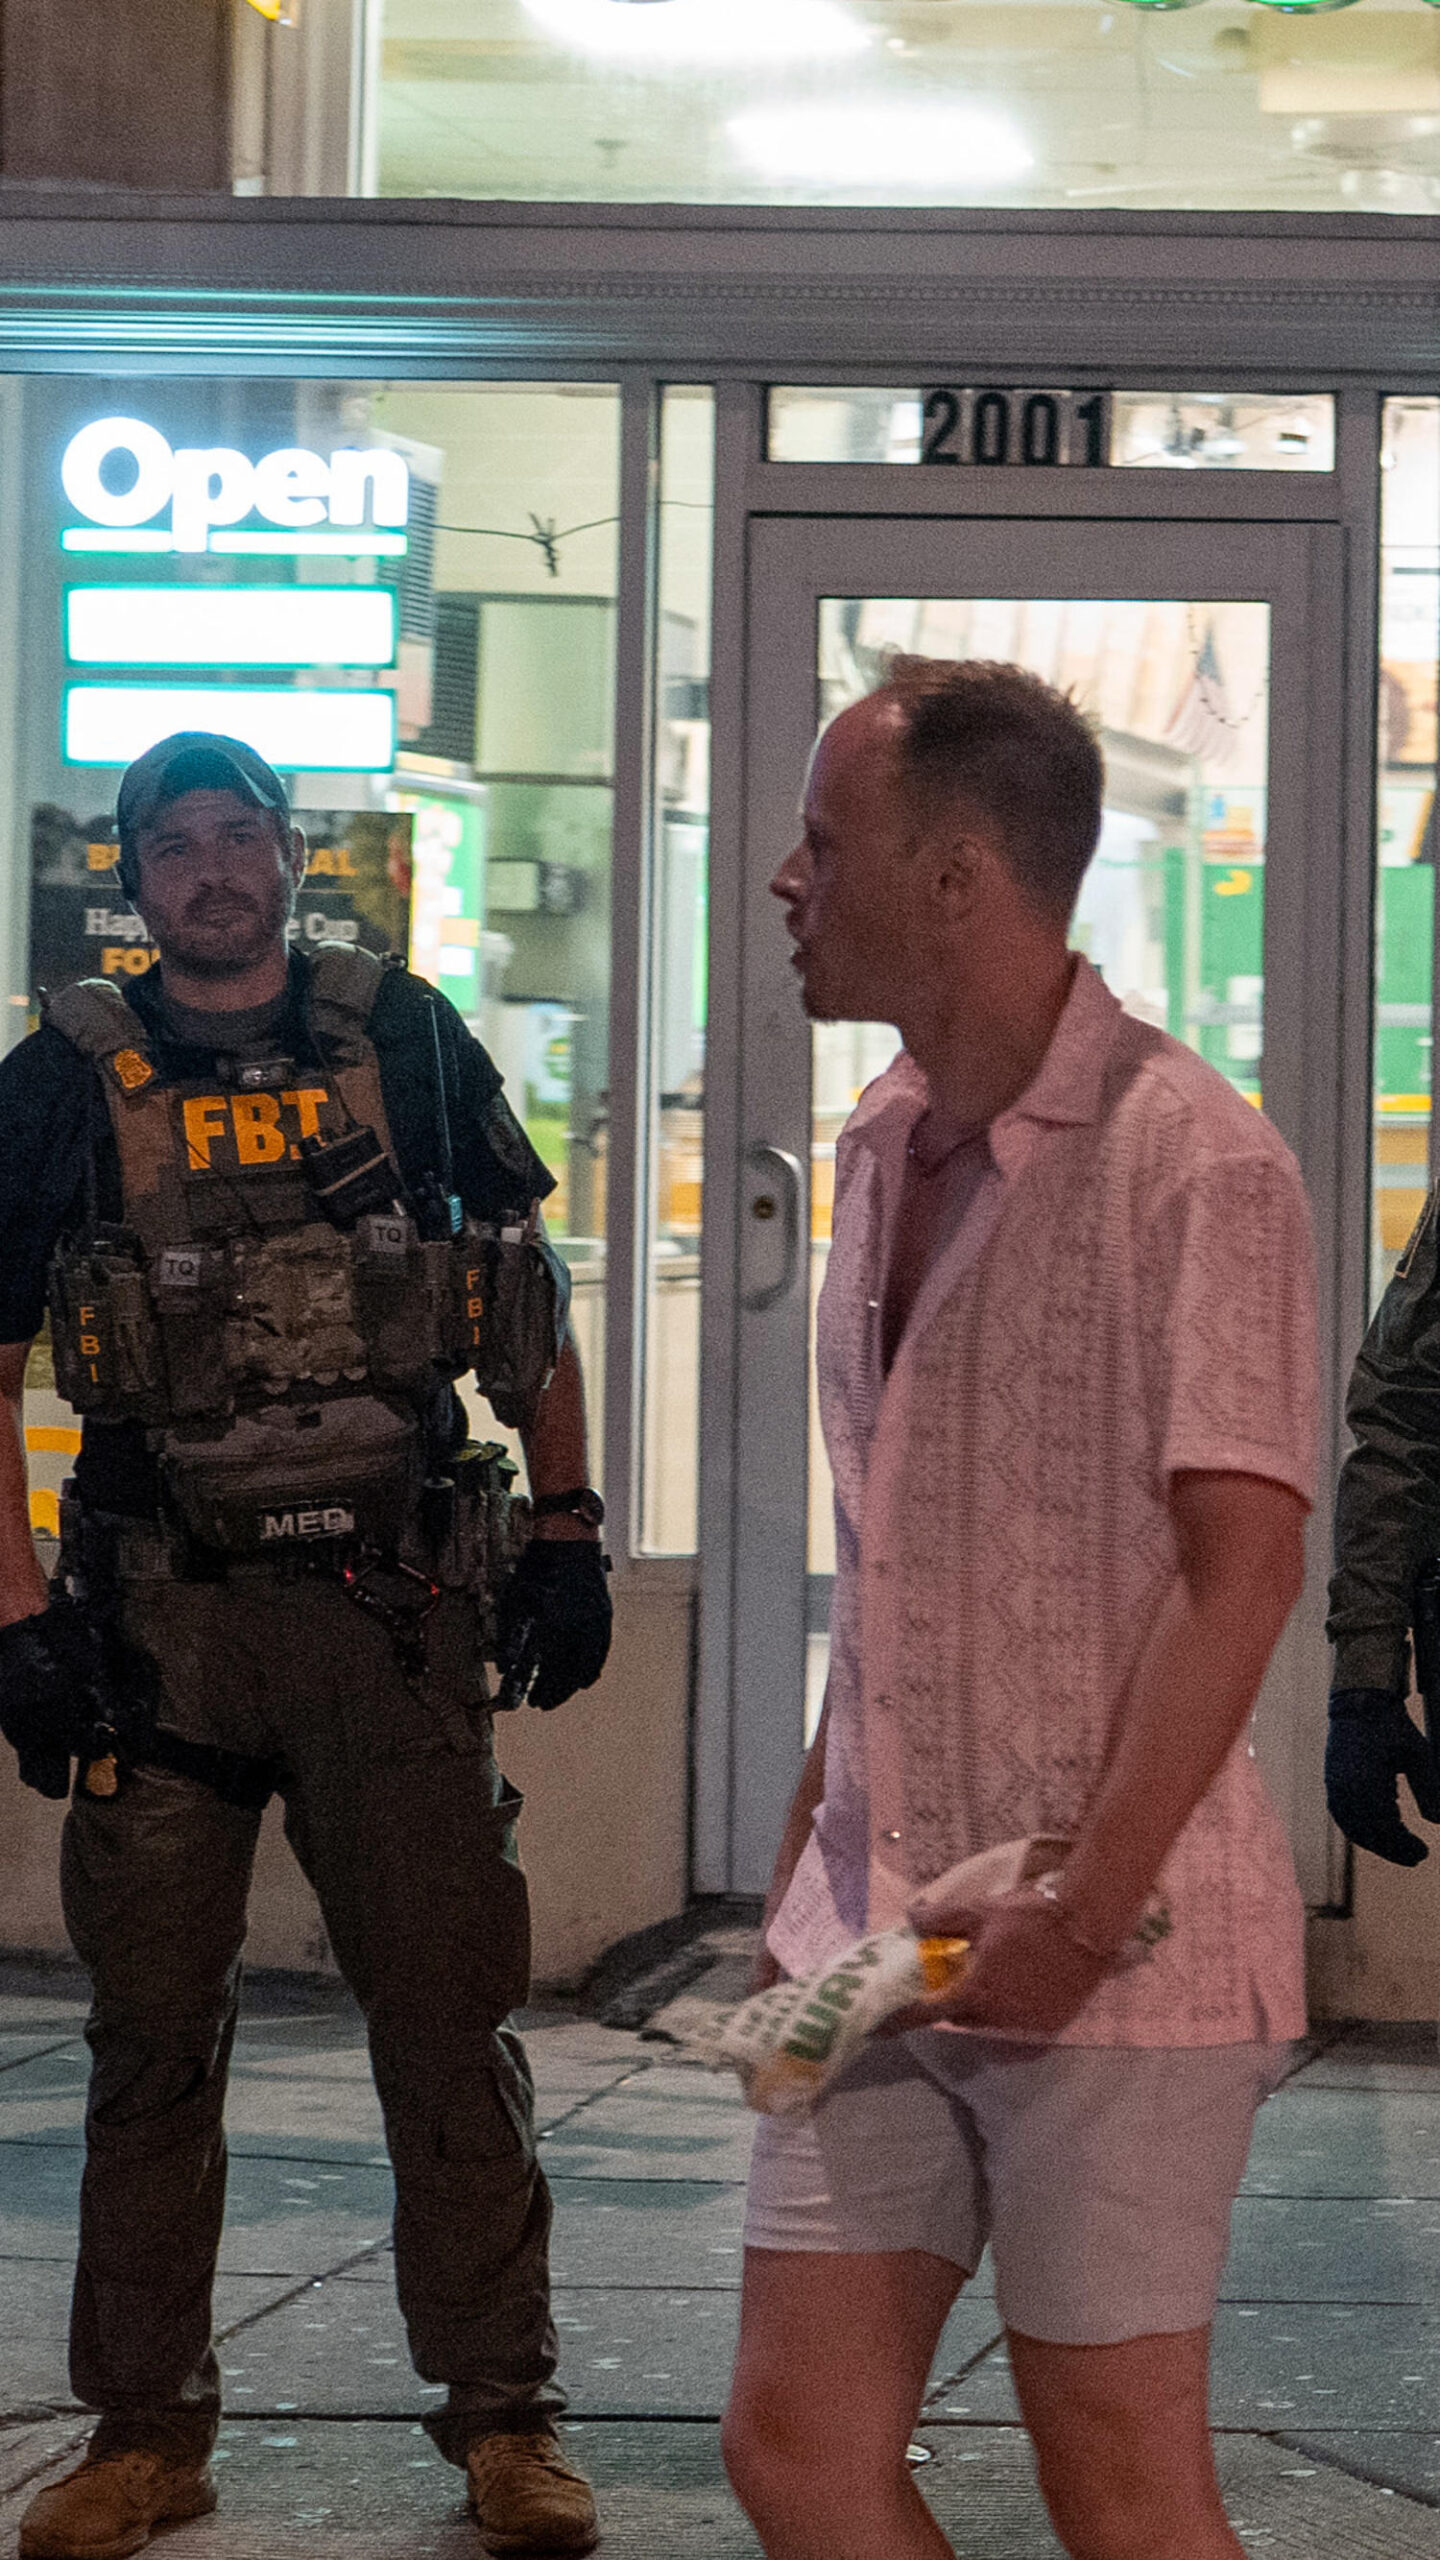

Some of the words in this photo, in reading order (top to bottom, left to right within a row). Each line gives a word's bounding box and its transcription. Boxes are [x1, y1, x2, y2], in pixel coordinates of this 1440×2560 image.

[923, 390, 1103, 466] 2001
[61, 416, 409, 552] Open
[183, 1088, 328, 1170] FBI
[373, 1225, 401, 1243] TQ
[165, 1259, 195, 1276] TQ
[262, 1508, 348, 1538] MED
